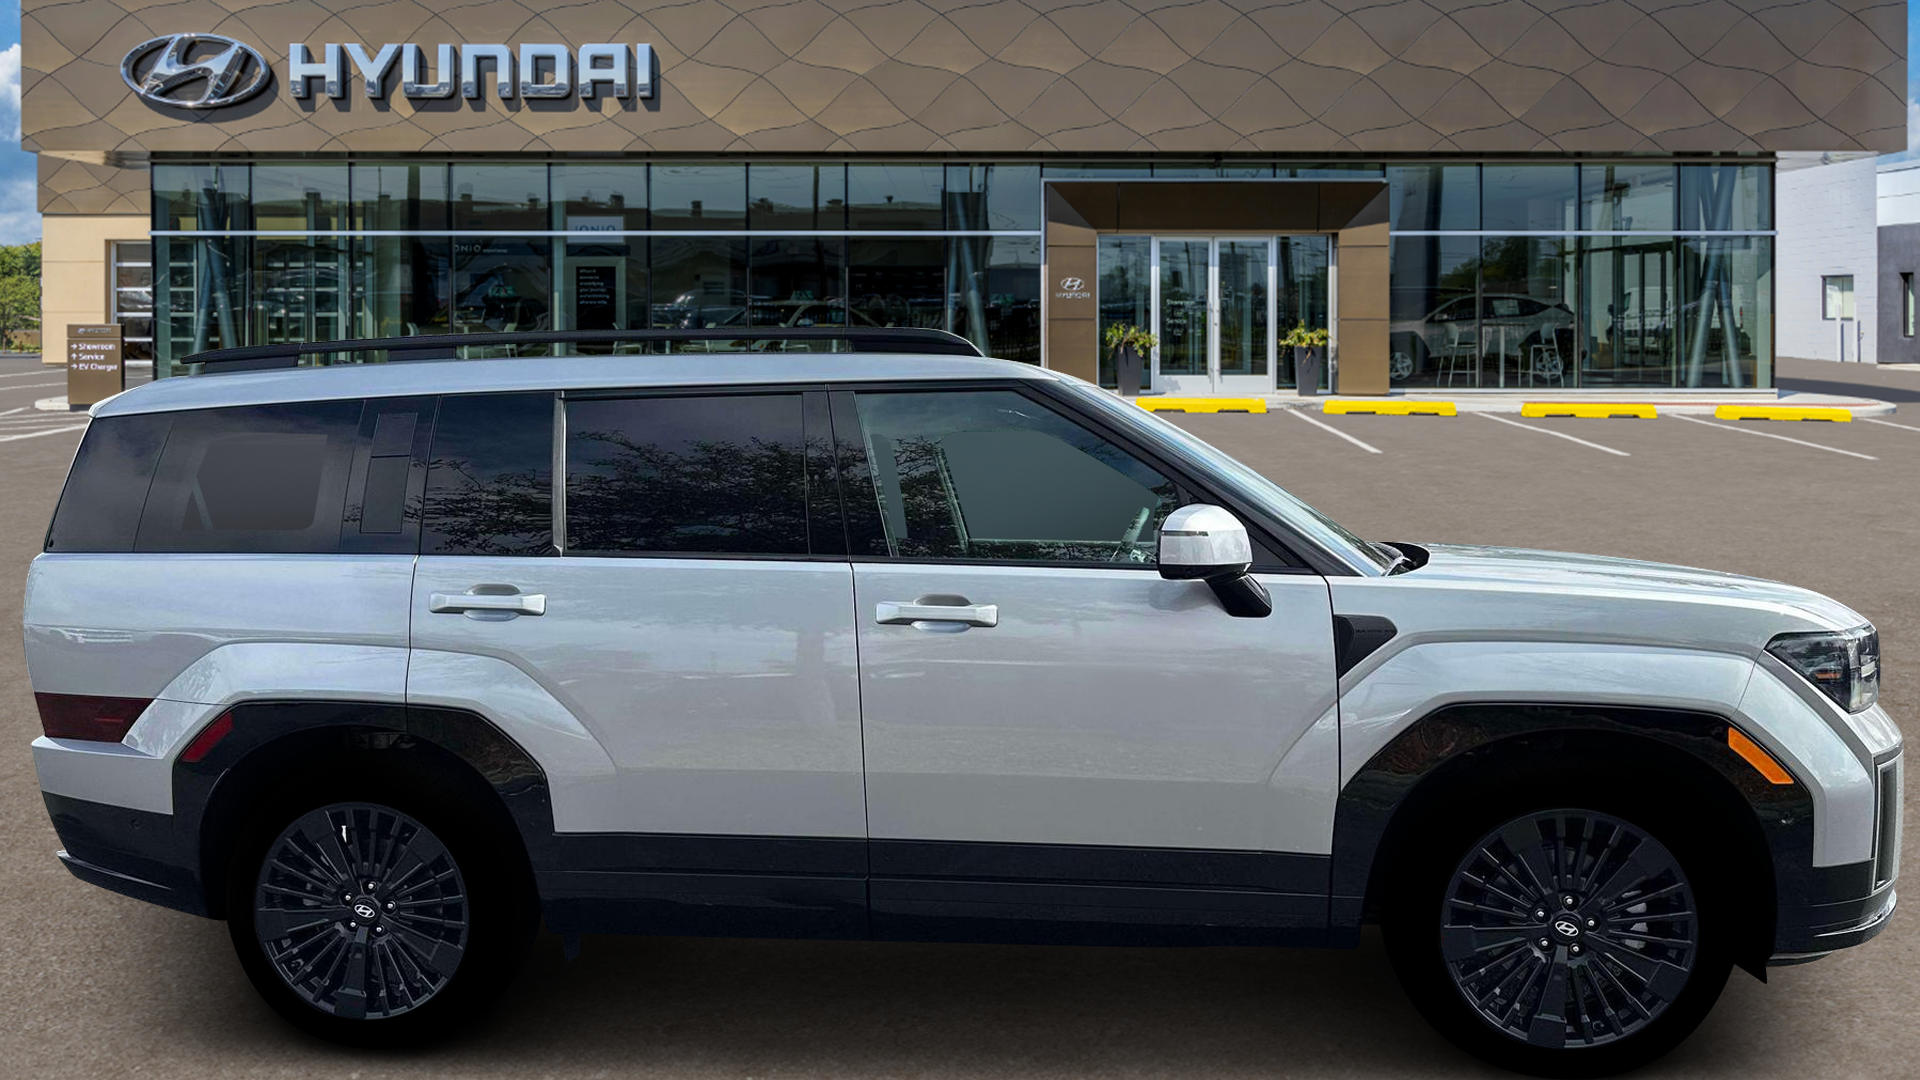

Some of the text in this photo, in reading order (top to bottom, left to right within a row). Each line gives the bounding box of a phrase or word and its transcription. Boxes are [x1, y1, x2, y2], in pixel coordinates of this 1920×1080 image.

[289, 43, 654, 98] HYUNDAI
[78, 352, 105, 360] Service
[90, 363, 118, 372] Charger
